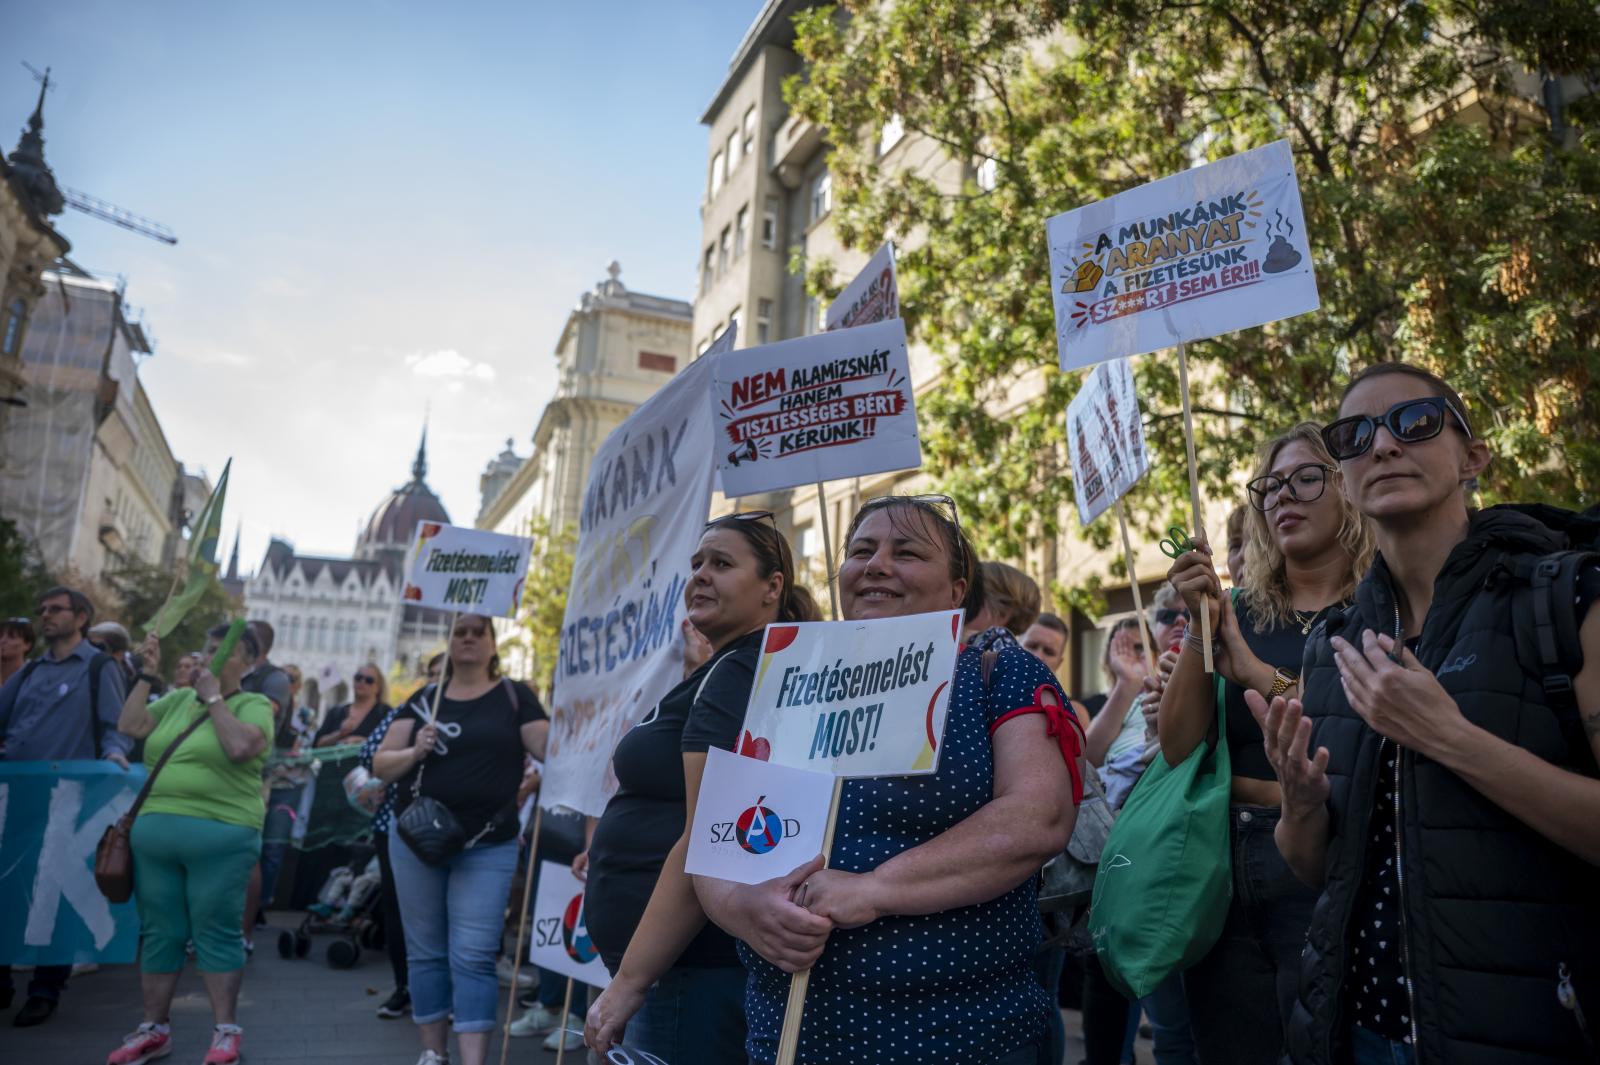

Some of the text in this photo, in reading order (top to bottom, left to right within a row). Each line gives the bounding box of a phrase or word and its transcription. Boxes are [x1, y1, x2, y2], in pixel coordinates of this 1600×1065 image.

[1094, 191, 1247, 254] A MUNKÁNK
[1105, 212, 1245, 276] ARANYAT
[1103, 246, 1248, 297] A FIZETÉSÜNK
[1179, 276, 1216, 297] SEM
[1221, 259, 1260, 285] ÉR!!!
[731, 368, 787, 408] NEM
[780, 384, 842, 411] HANEM
[736, 392, 897, 441] TISZTESSÉGES BÉRT
[780, 417, 877, 453] KÉRÜNK!!
[426, 548, 520, 574] Fizetésemelést
[443, 578, 489, 605] MOST!
[776, 642, 935, 708] Fizetésemelést
[809, 702, 885, 760] MOST!
[710, 795, 801, 849] SZÁD
